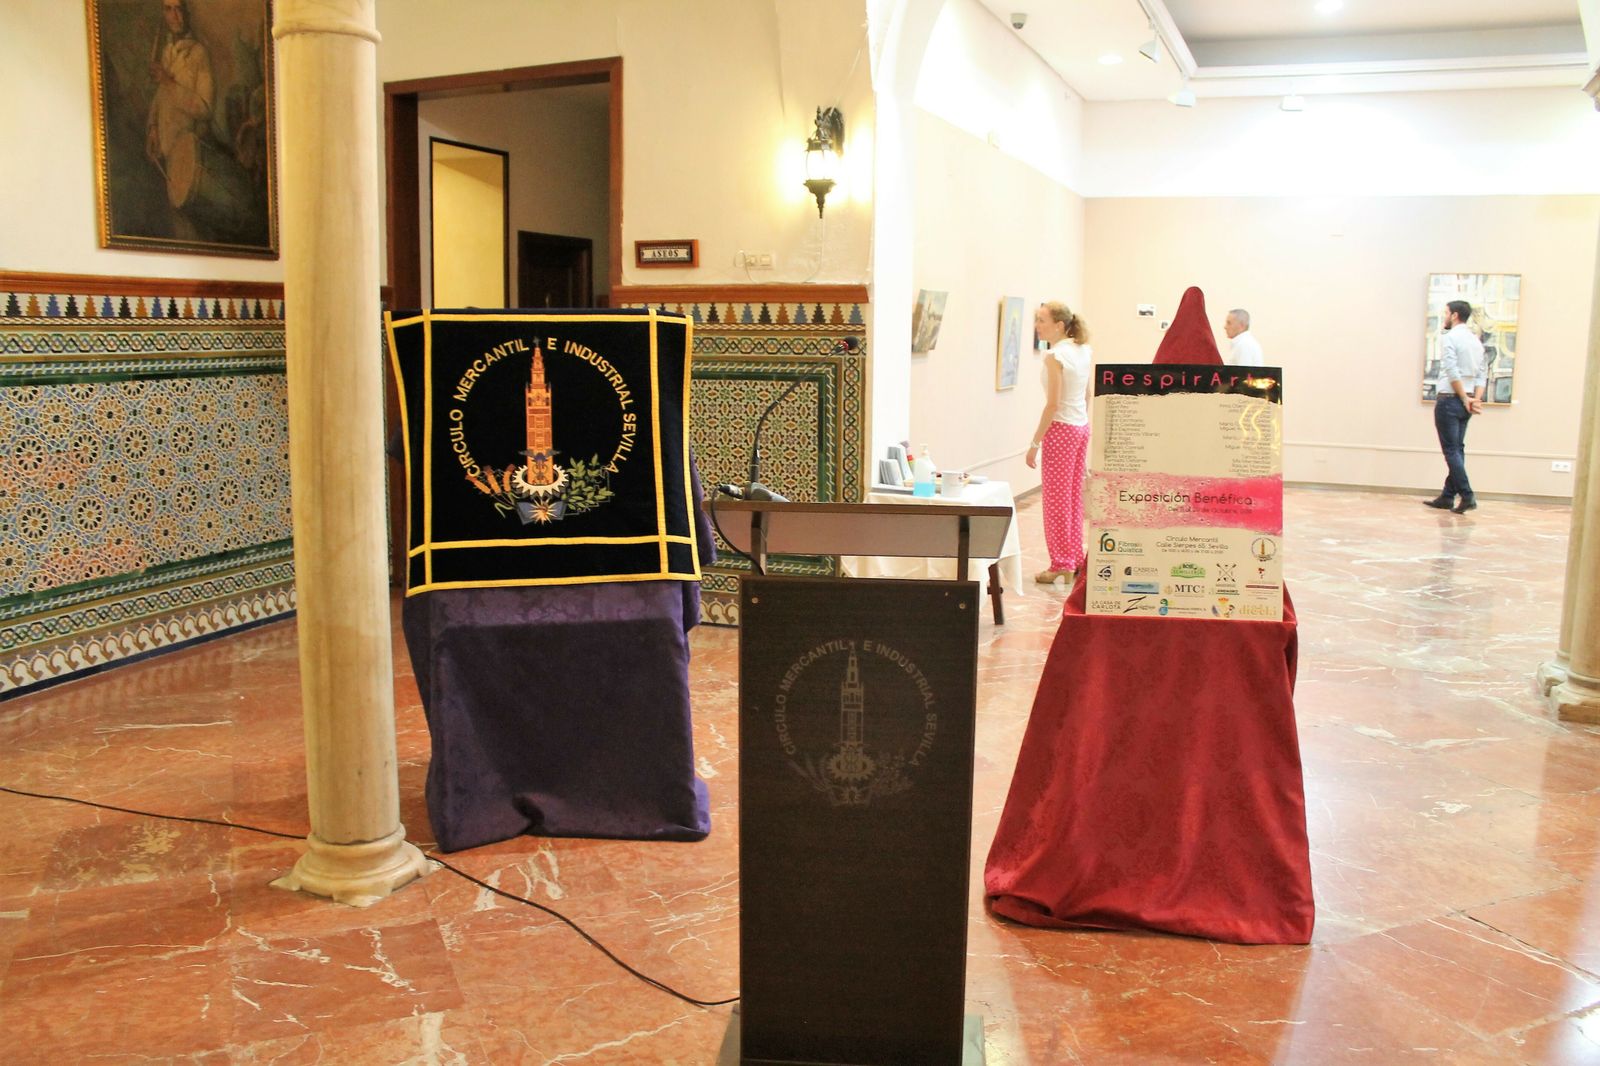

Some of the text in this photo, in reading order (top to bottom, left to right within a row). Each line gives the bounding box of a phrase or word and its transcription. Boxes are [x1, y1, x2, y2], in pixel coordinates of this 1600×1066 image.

[652, 249, 679, 258] ASEOS
[449, 337, 637, 478] CIRCULO MERCANTIL E INDUSTRIAL SEVILLA
[1119, 490, 1253, 505] Exposición Benéfica
[1175, 584, 1201, 594] MTC
[863, 640, 873, 651] E
[779, 639, 849, 692] MERCANTIL
[876, 643, 936, 710] INDUSTRIAL
[775, 694, 797, 755] CIRCULO
